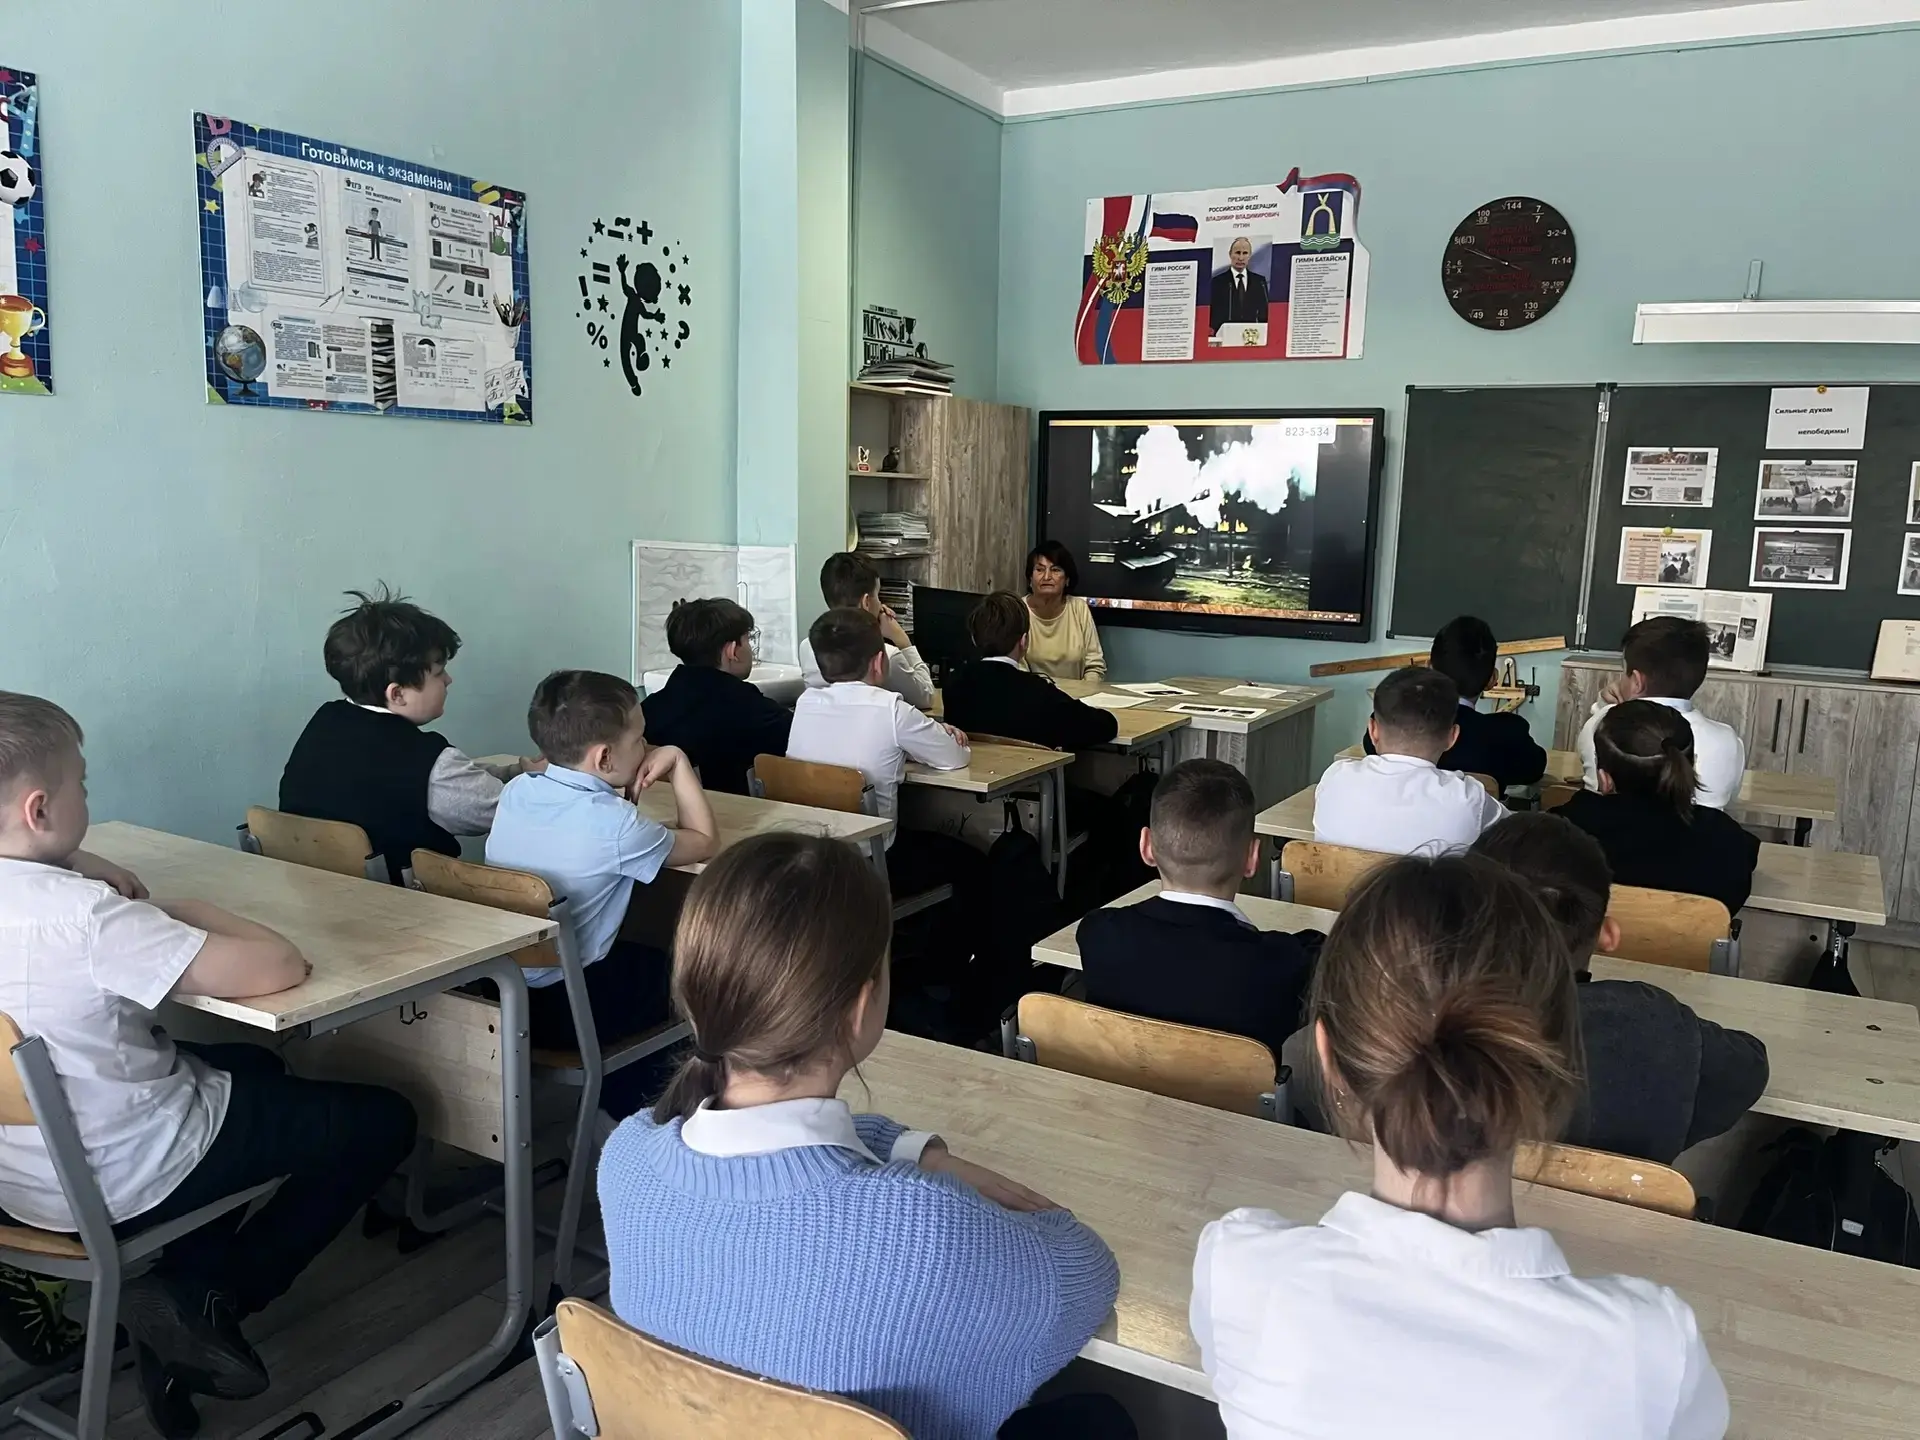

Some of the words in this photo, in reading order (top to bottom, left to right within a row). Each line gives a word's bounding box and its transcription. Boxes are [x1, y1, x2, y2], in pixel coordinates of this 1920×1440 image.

[301, 142, 374, 172] Готовимся
[378, 163, 385, 175] к
[388, 166, 453, 192] экзаменам
[1227, 195, 1259, 203] ПРЕЗИДЕНТ
[1208, 204, 1244, 213] РОССИЙСКОЙ
[1245, 203, 1278, 211] ФЕДЕРАЦИИ
[1206, 214, 1235, 222] ВЛАДИМИР
[1235, 212, 1280, 221] ВЛАДИМИРОВИЧ
[1315, 255, 1347, 263] БАТАЙСКА
[1168, 264, 1191, 272] РОССИИ
[1808, 406, 1833, 415] духом
[1285, 427, 1330, 437] 823-534
[1797, 427, 1850, 436] непобедимы!
